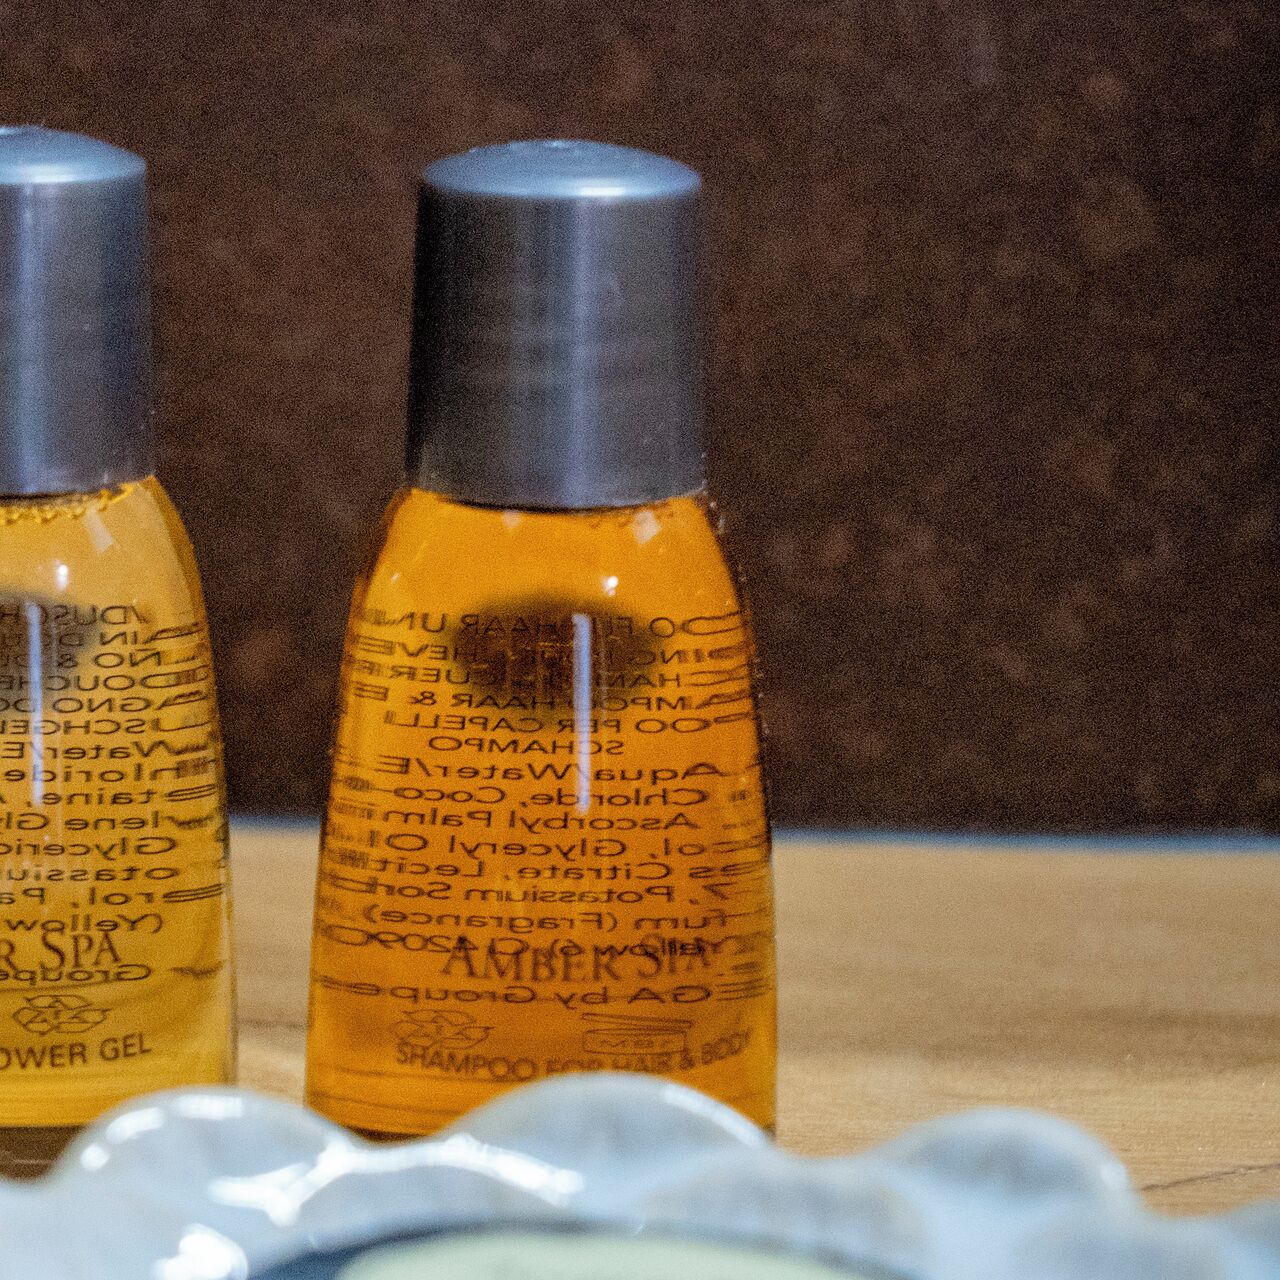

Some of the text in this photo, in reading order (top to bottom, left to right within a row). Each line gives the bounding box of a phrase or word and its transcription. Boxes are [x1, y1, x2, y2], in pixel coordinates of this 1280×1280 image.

[39, 929, 122, 972] SPA
[99, 1033, 152, 1061] GEL
[396, 1040, 537, 1080] SHAMPOO
